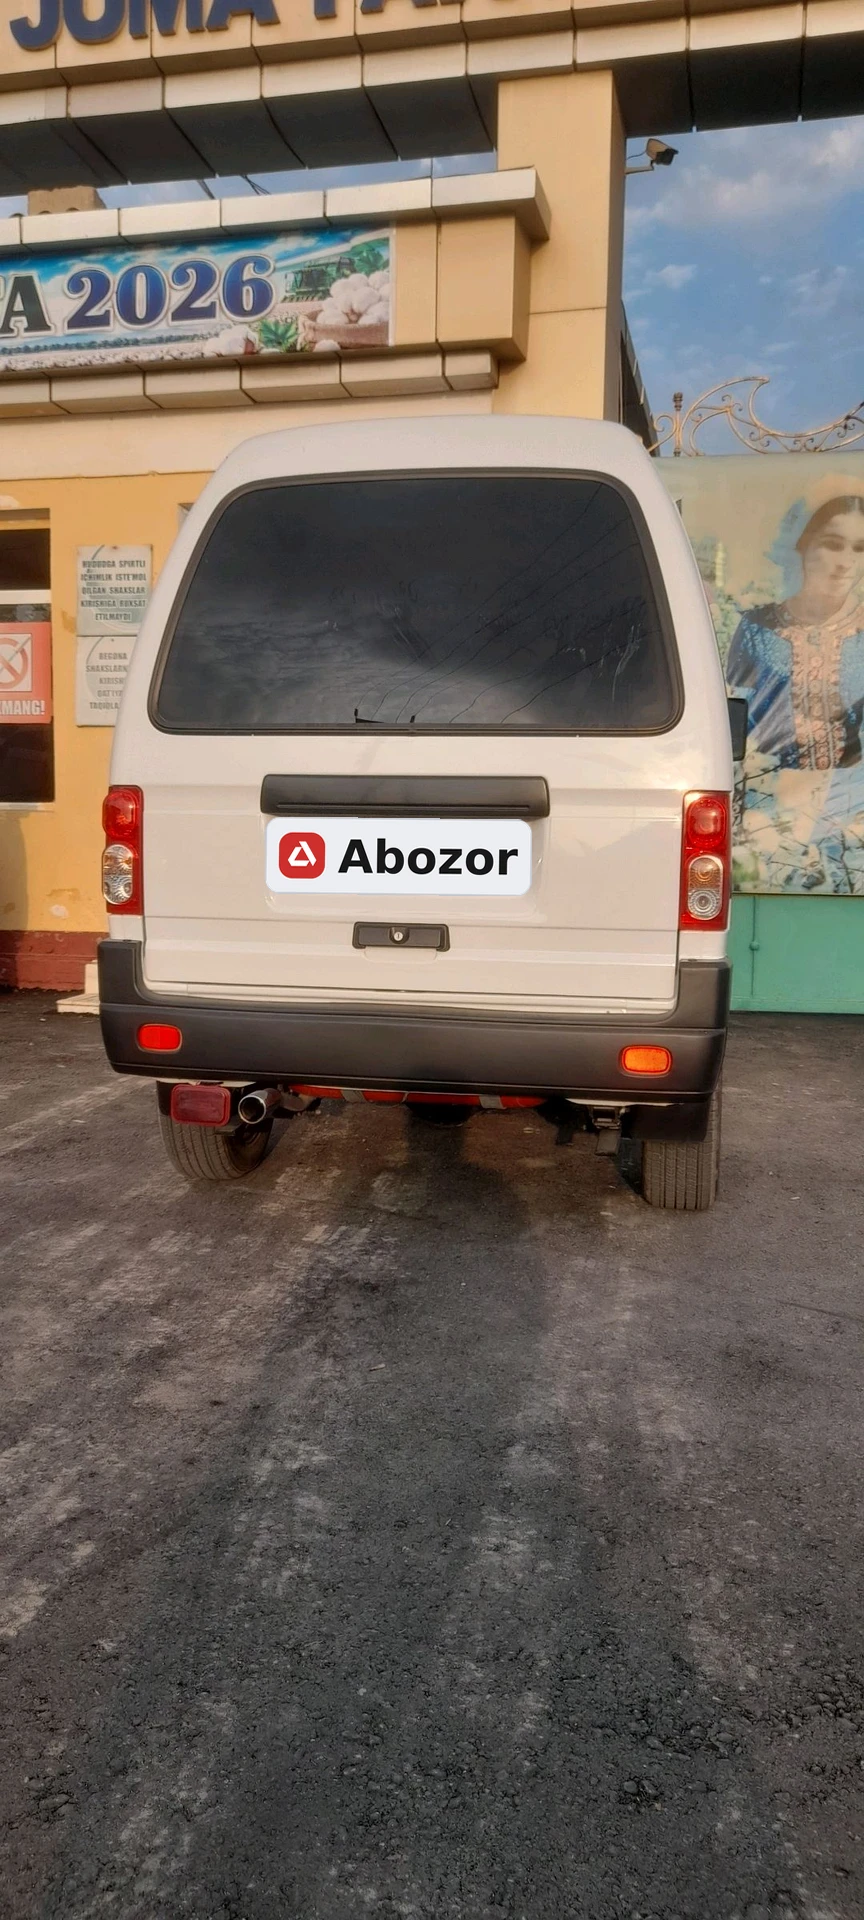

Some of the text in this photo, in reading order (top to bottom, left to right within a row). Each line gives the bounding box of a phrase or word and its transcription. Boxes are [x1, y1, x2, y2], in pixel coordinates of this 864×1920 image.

[66, 254, 275, 332] 2026
[98, 652, 128, 661] BEGONA
[0, 700, 46, 716] MANG!
